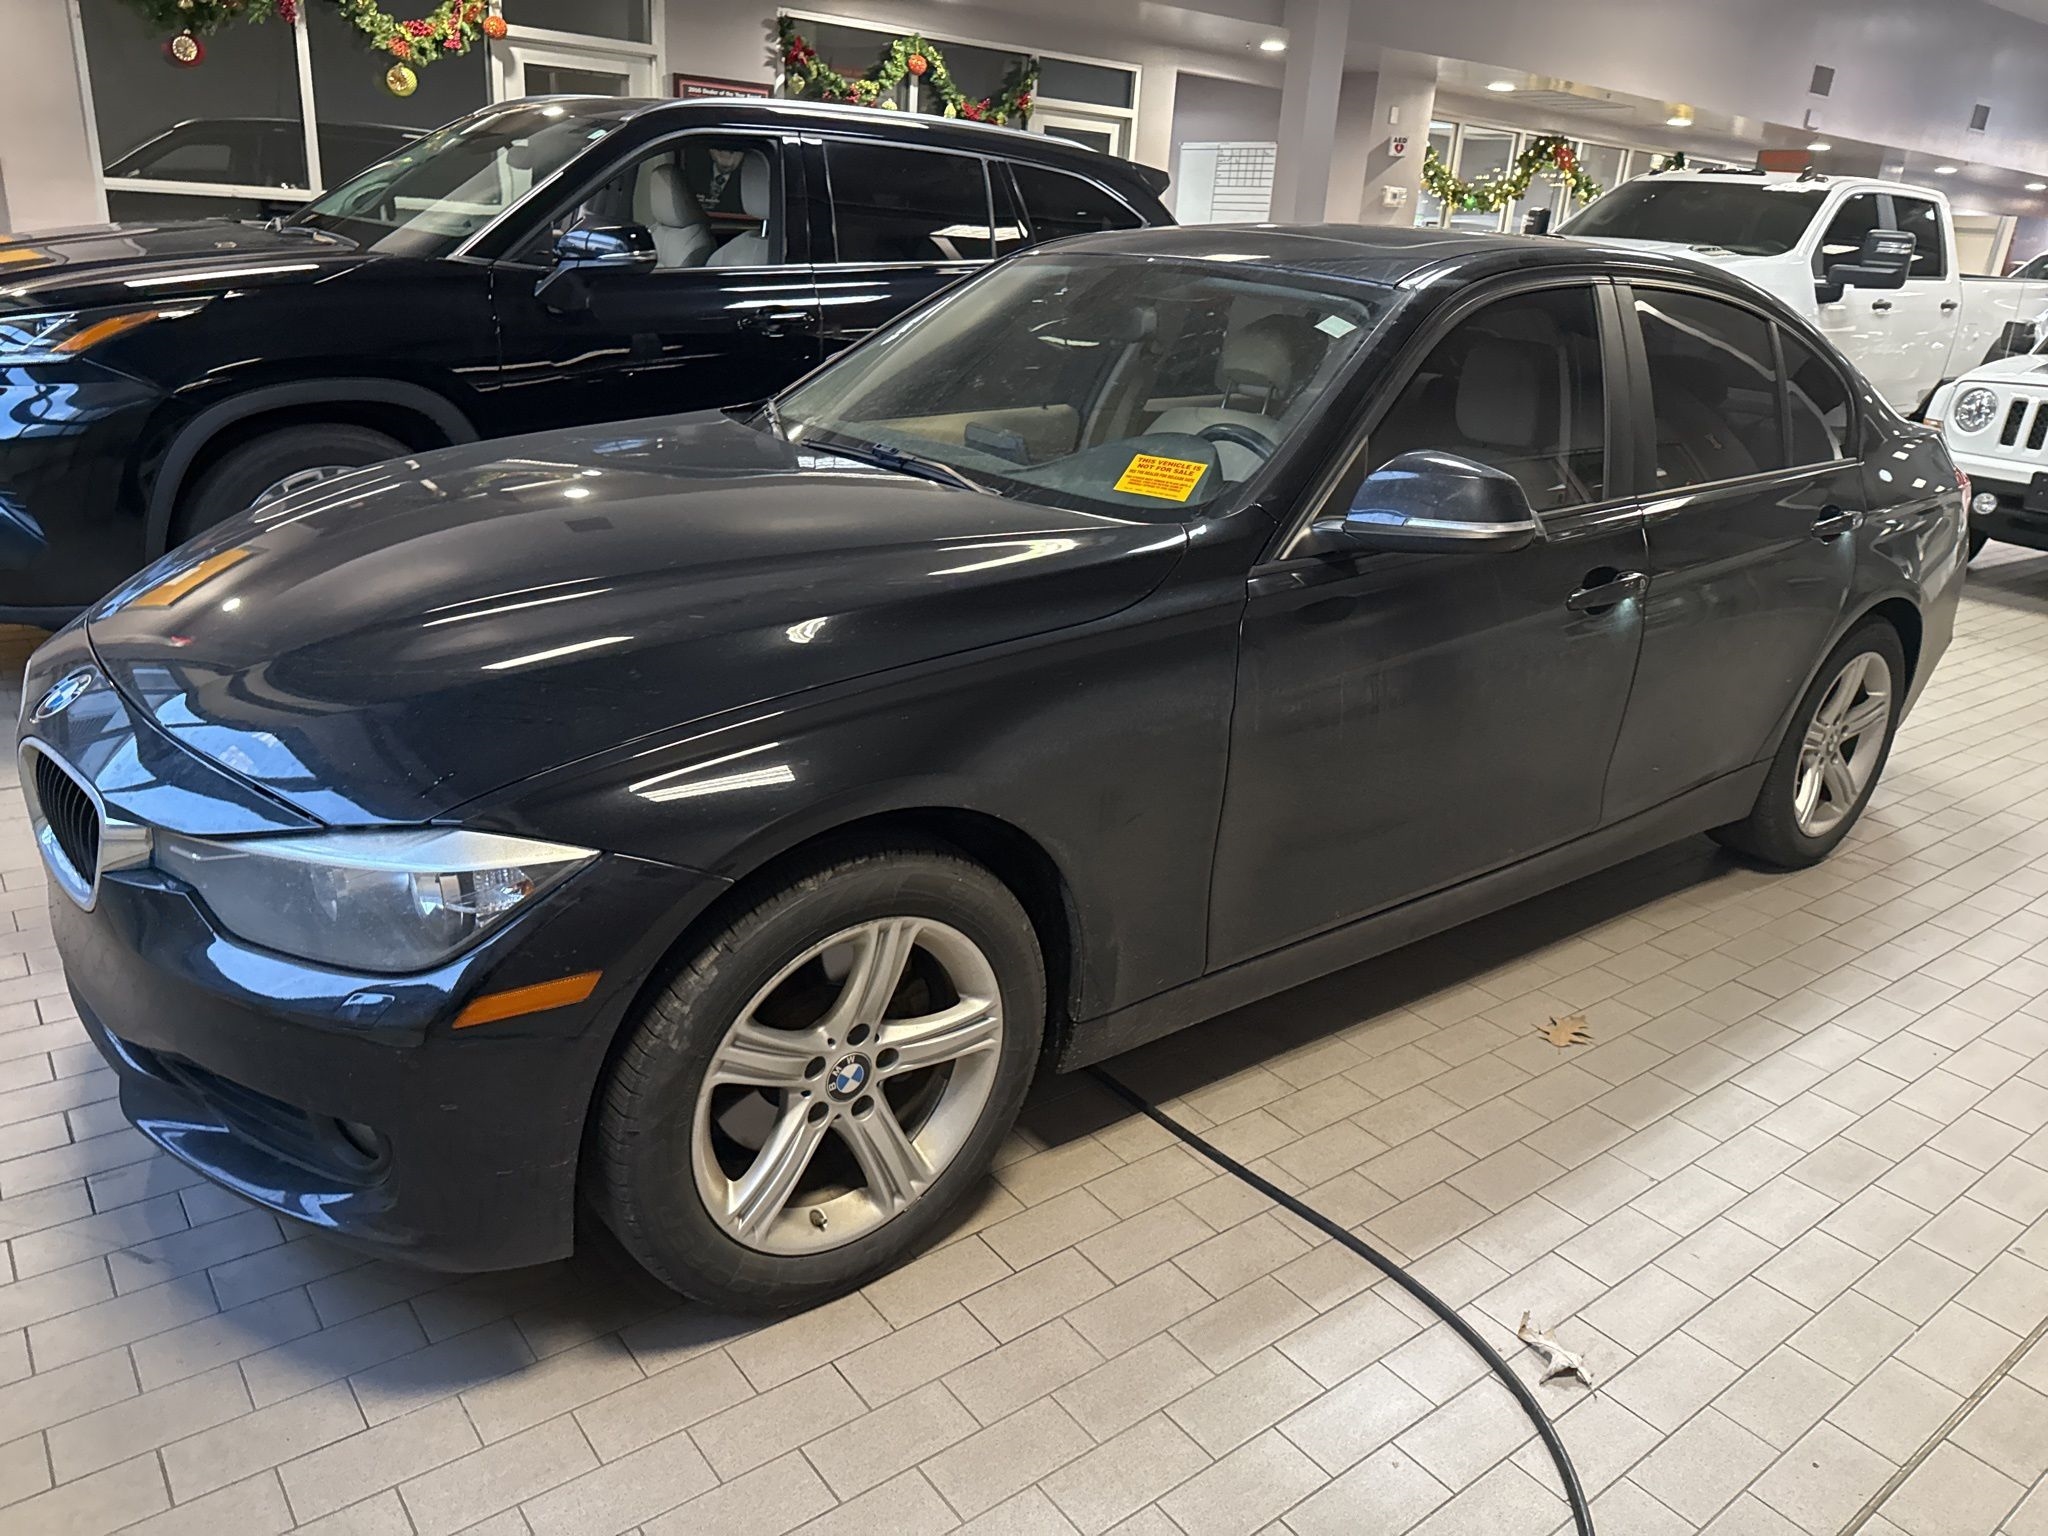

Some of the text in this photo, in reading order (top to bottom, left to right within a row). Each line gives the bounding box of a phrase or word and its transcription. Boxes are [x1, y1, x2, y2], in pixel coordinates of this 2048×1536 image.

[1393, 136, 1408, 144] AED
[1158, 459, 1192, 469] VEHICLE
[1156, 465, 1172, 473] FOR
[1173, 468, 1195, 477] SALE
